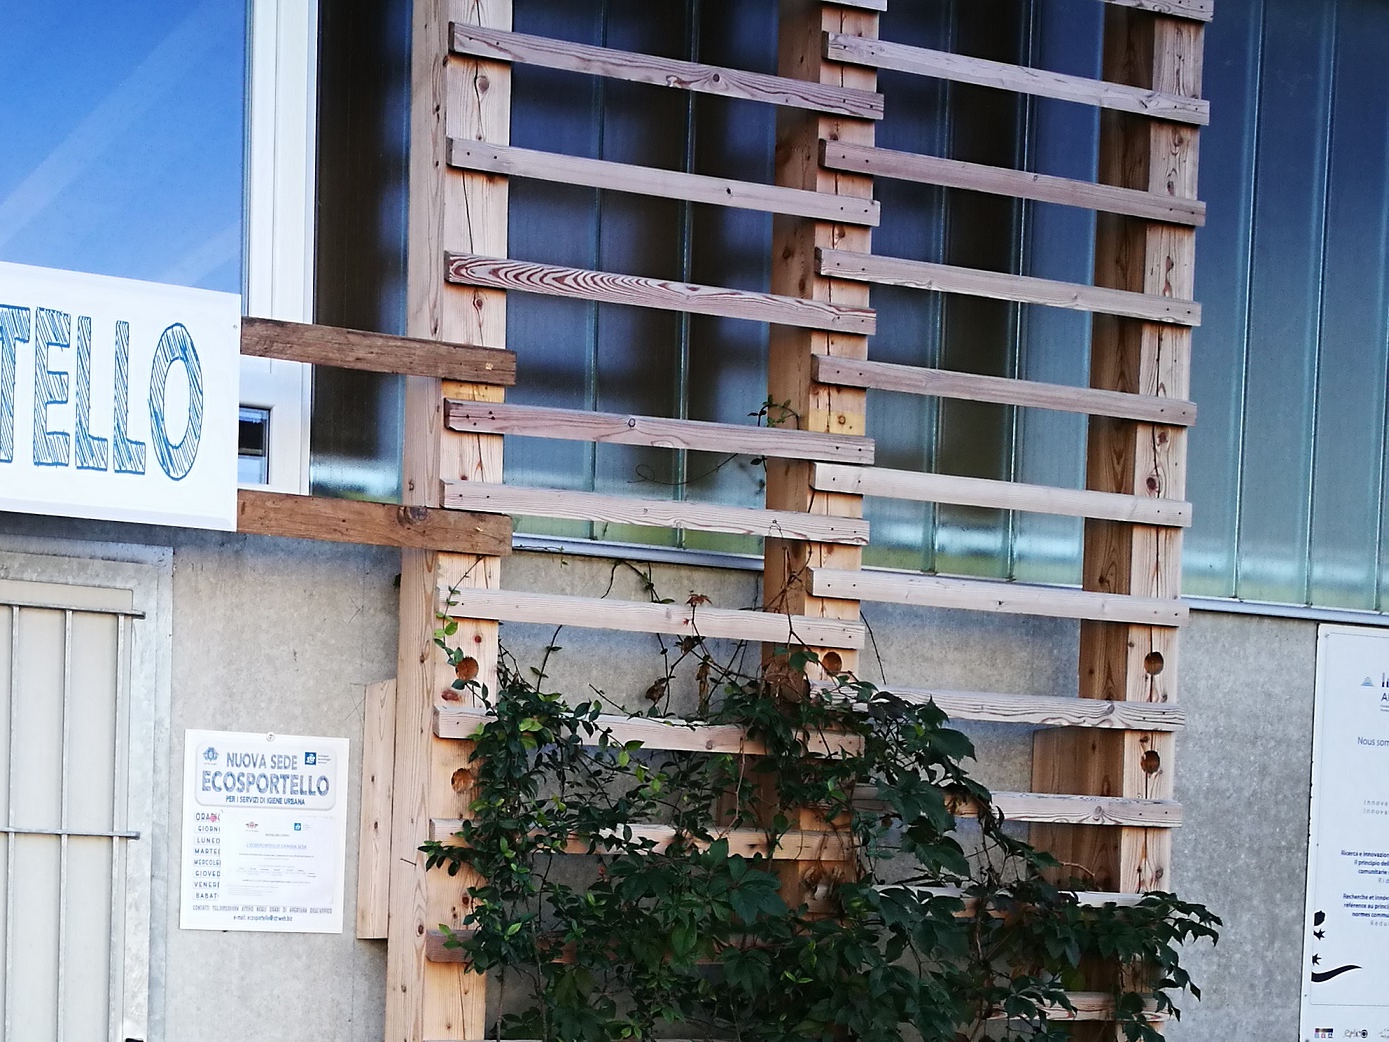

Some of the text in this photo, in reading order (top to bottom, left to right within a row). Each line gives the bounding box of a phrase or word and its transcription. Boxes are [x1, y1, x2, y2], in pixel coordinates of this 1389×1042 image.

[1357, 736, 1375, 746] Nous
[226, 752, 267, 769] NUOVA
[271, 754, 298, 770] SEDE
[201, 770, 330, 796] ECOSPORTELLO
[226, 795, 236, 803] PER
[239, 796, 259, 804] SERVIZI
[284, 797, 305, 805] URBANA
